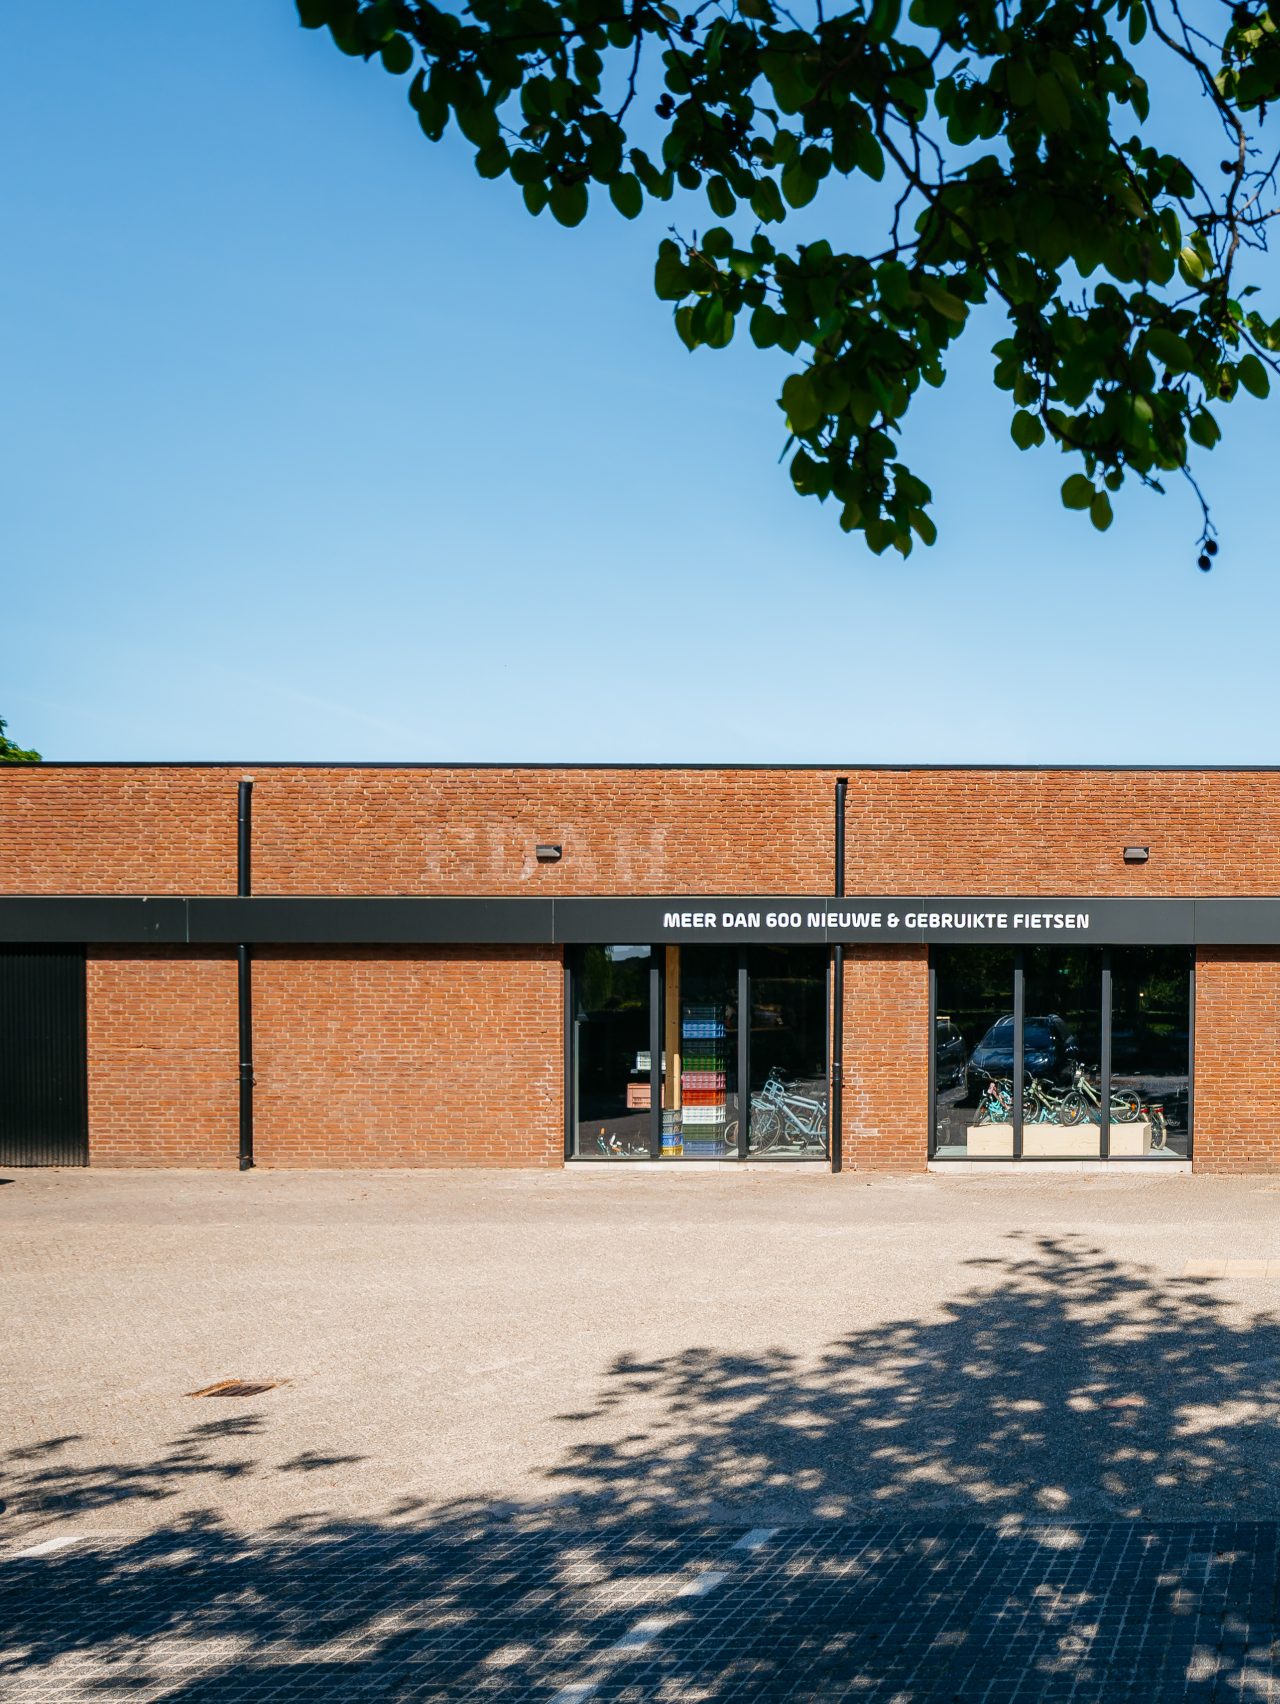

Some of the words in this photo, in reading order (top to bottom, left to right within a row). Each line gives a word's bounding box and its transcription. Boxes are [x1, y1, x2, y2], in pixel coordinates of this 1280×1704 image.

[663, 912, 717, 928] MEER
[722, 912, 760, 928] DAN
[765, 912, 802, 928] 600
[807, 912, 882, 928] NIEUWE
[887, 913, 900, 928] &
[904, 913, 1008, 929] GEBRUIKTE
[1013, 913, 1089, 929] FIETSEN
